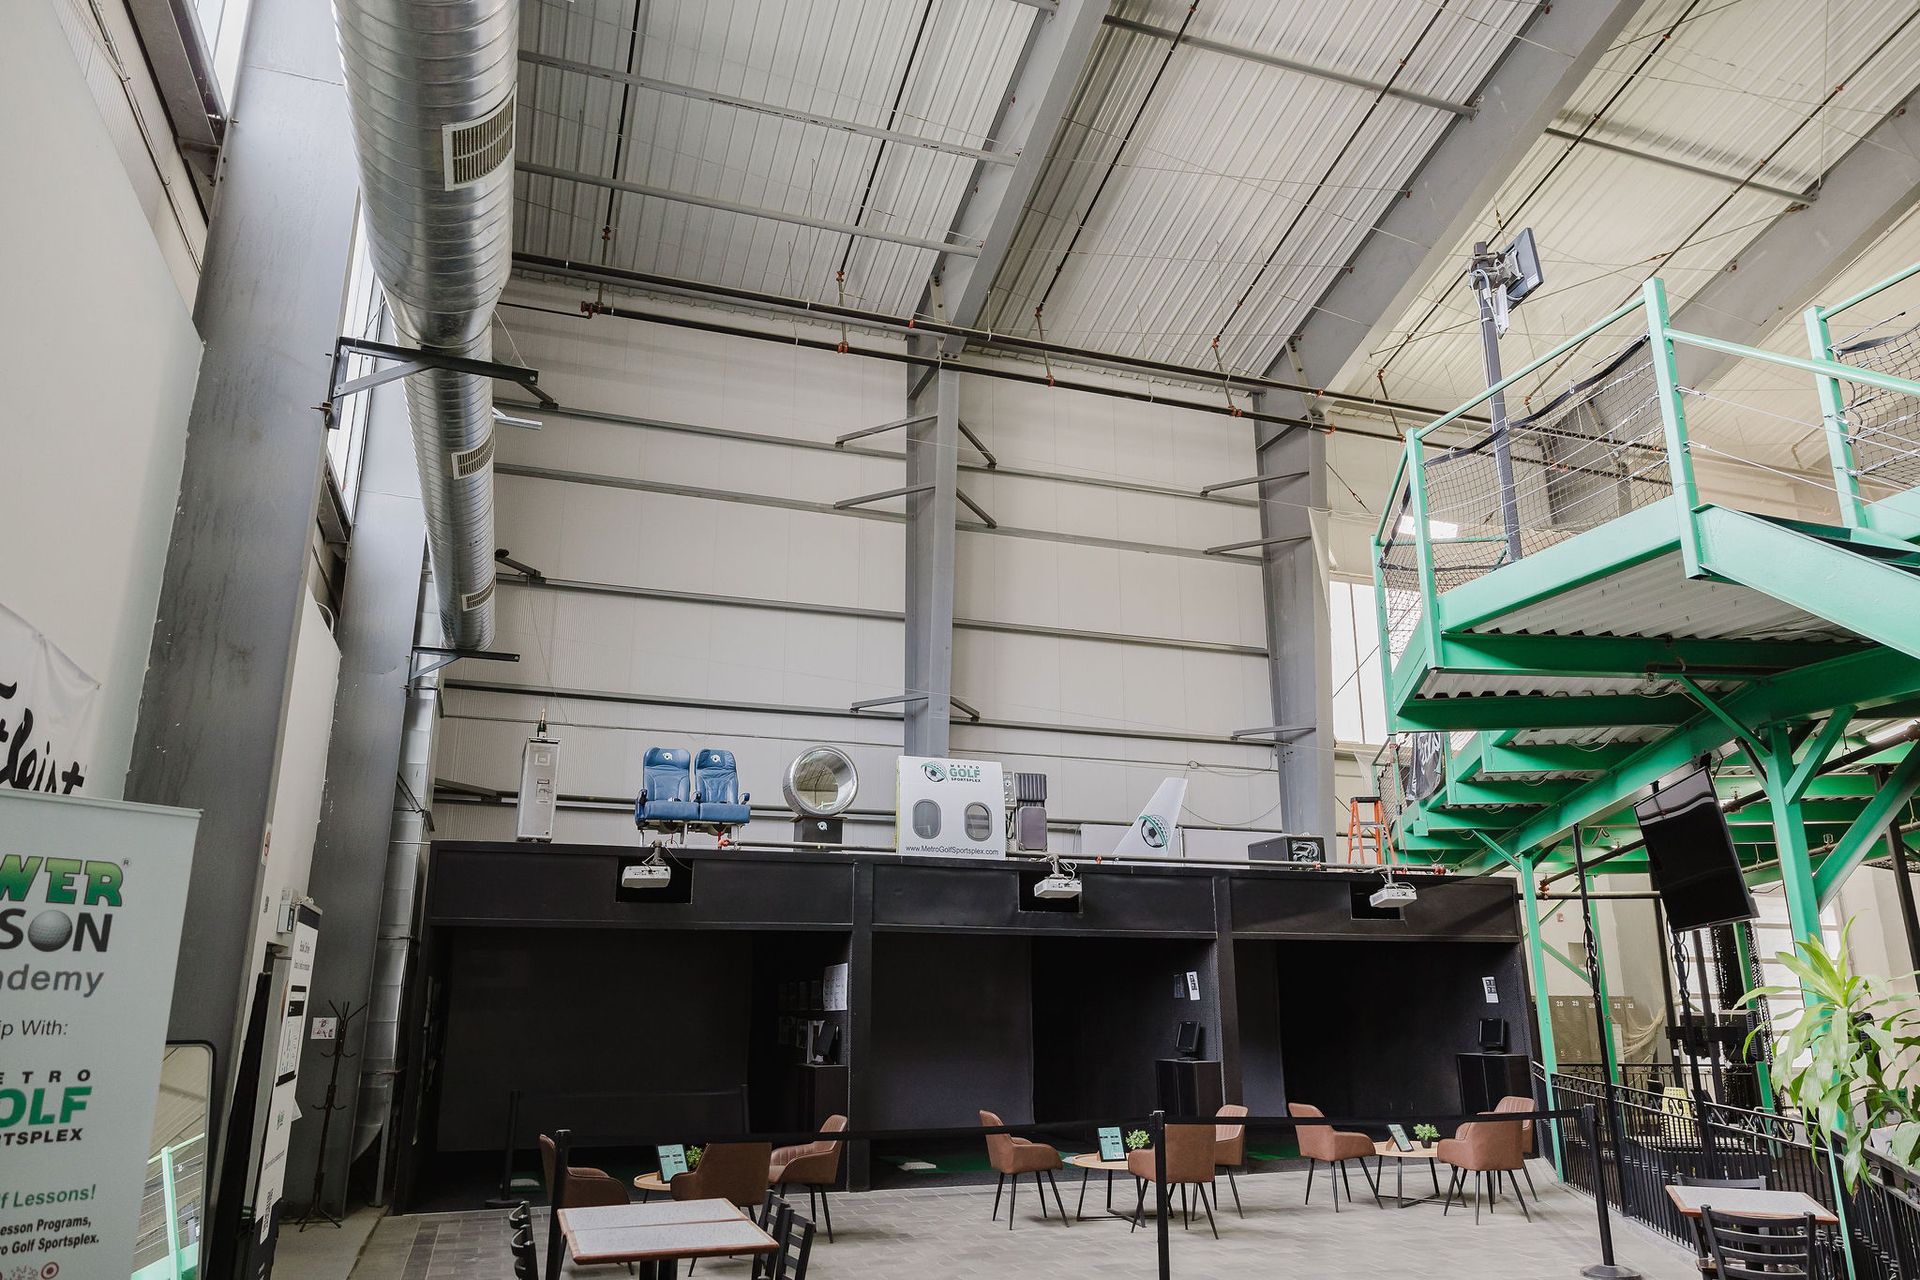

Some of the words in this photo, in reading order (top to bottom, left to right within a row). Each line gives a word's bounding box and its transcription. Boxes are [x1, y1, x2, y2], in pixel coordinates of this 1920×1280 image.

[949, 768, 980, 778] GOLF
[905, 845, 999, 856] www.MetroGolfSportsplex.com
[0, 963, 104, 998] demy
[22, 1019, 68, 1036] With:
[0, 1128, 83, 1146] TSPLEX
[13, 1184, 96, 1208] Lessons!
[36, 1216, 91, 1232] Programs,
[12, 1238, 36, 1254] Golf
[38, 1233, 99, 1252] Sportsplex.
